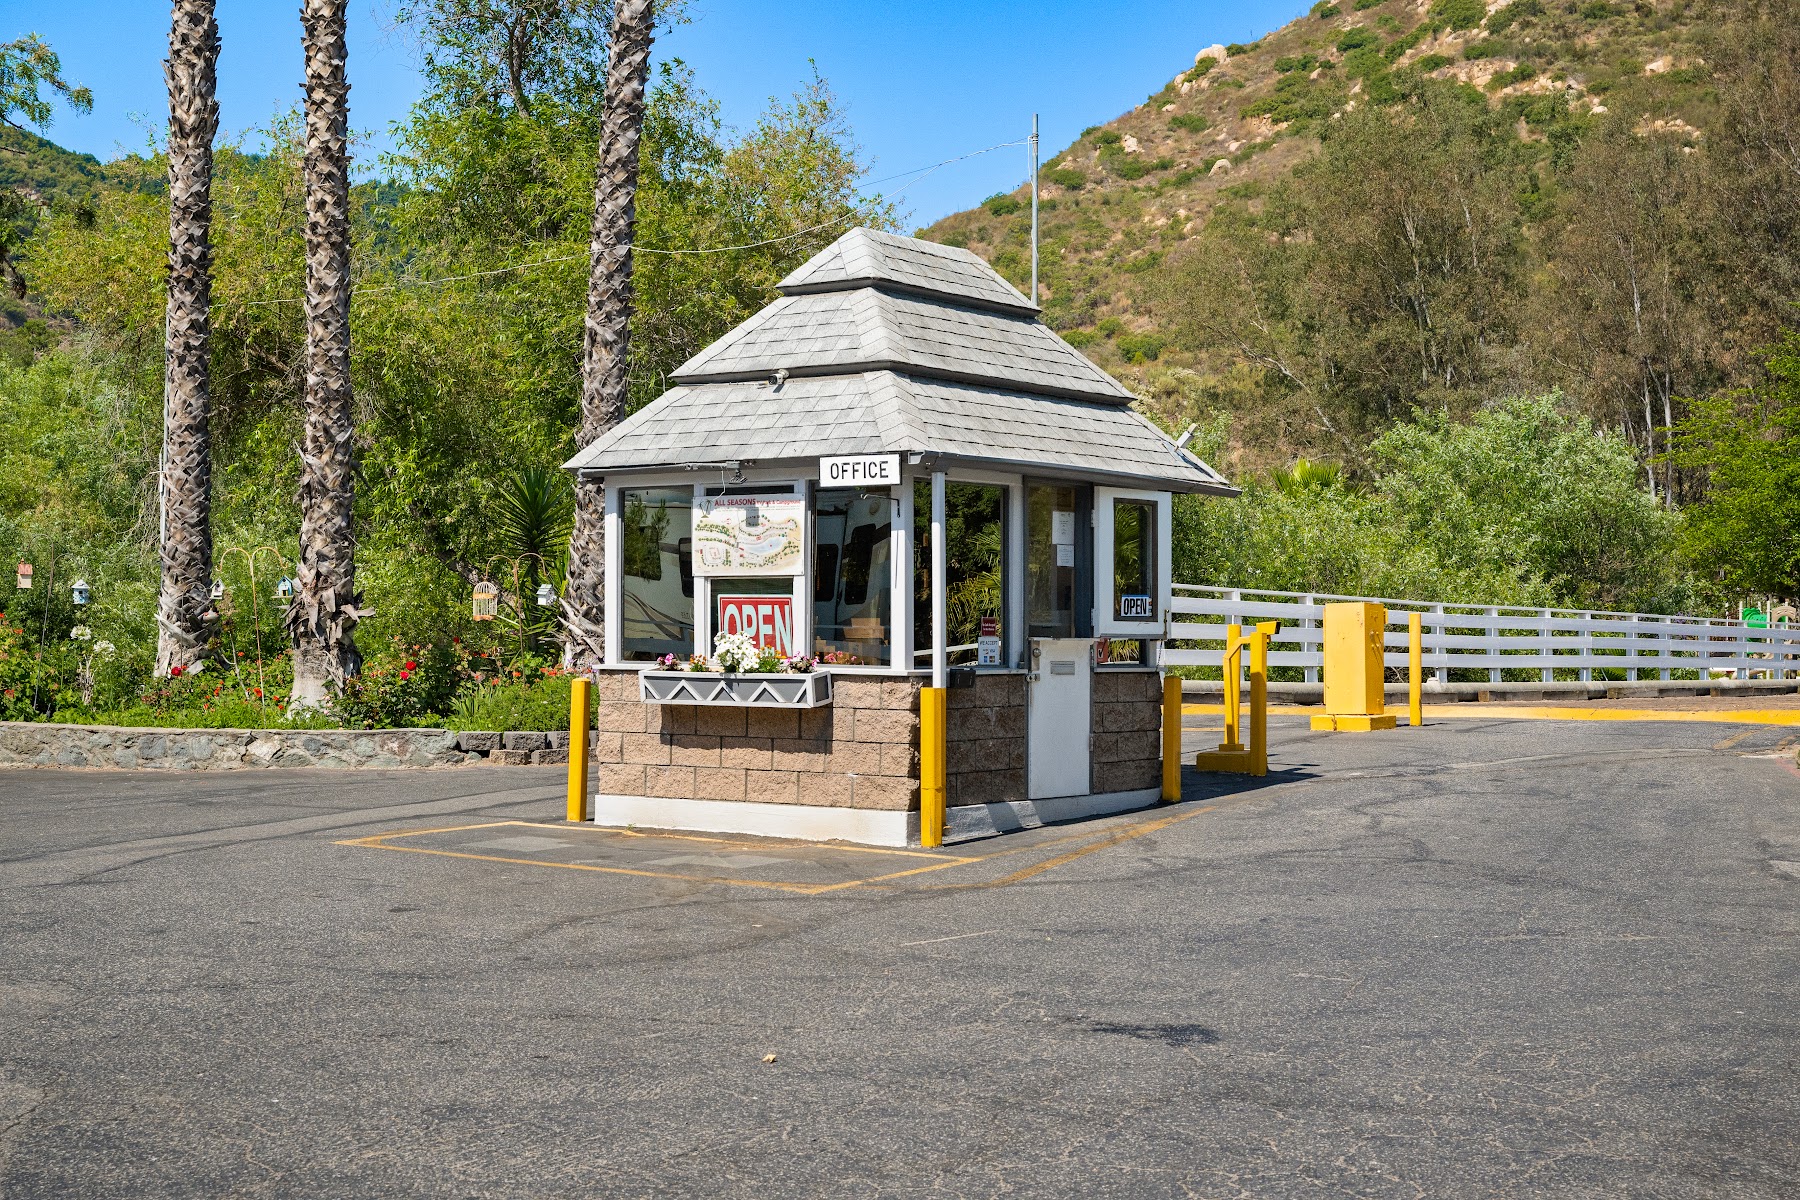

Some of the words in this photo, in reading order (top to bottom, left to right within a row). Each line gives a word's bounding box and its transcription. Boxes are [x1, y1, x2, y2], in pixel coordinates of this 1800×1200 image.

[830, 461, 889, 480] OFFICE
[714, 499, 726, 507] ALL
[727, 498, 756, 506] SEASONS
[1123, 597, 1147, 616] OPEN
[724, 603, 792, 657] OPEN
